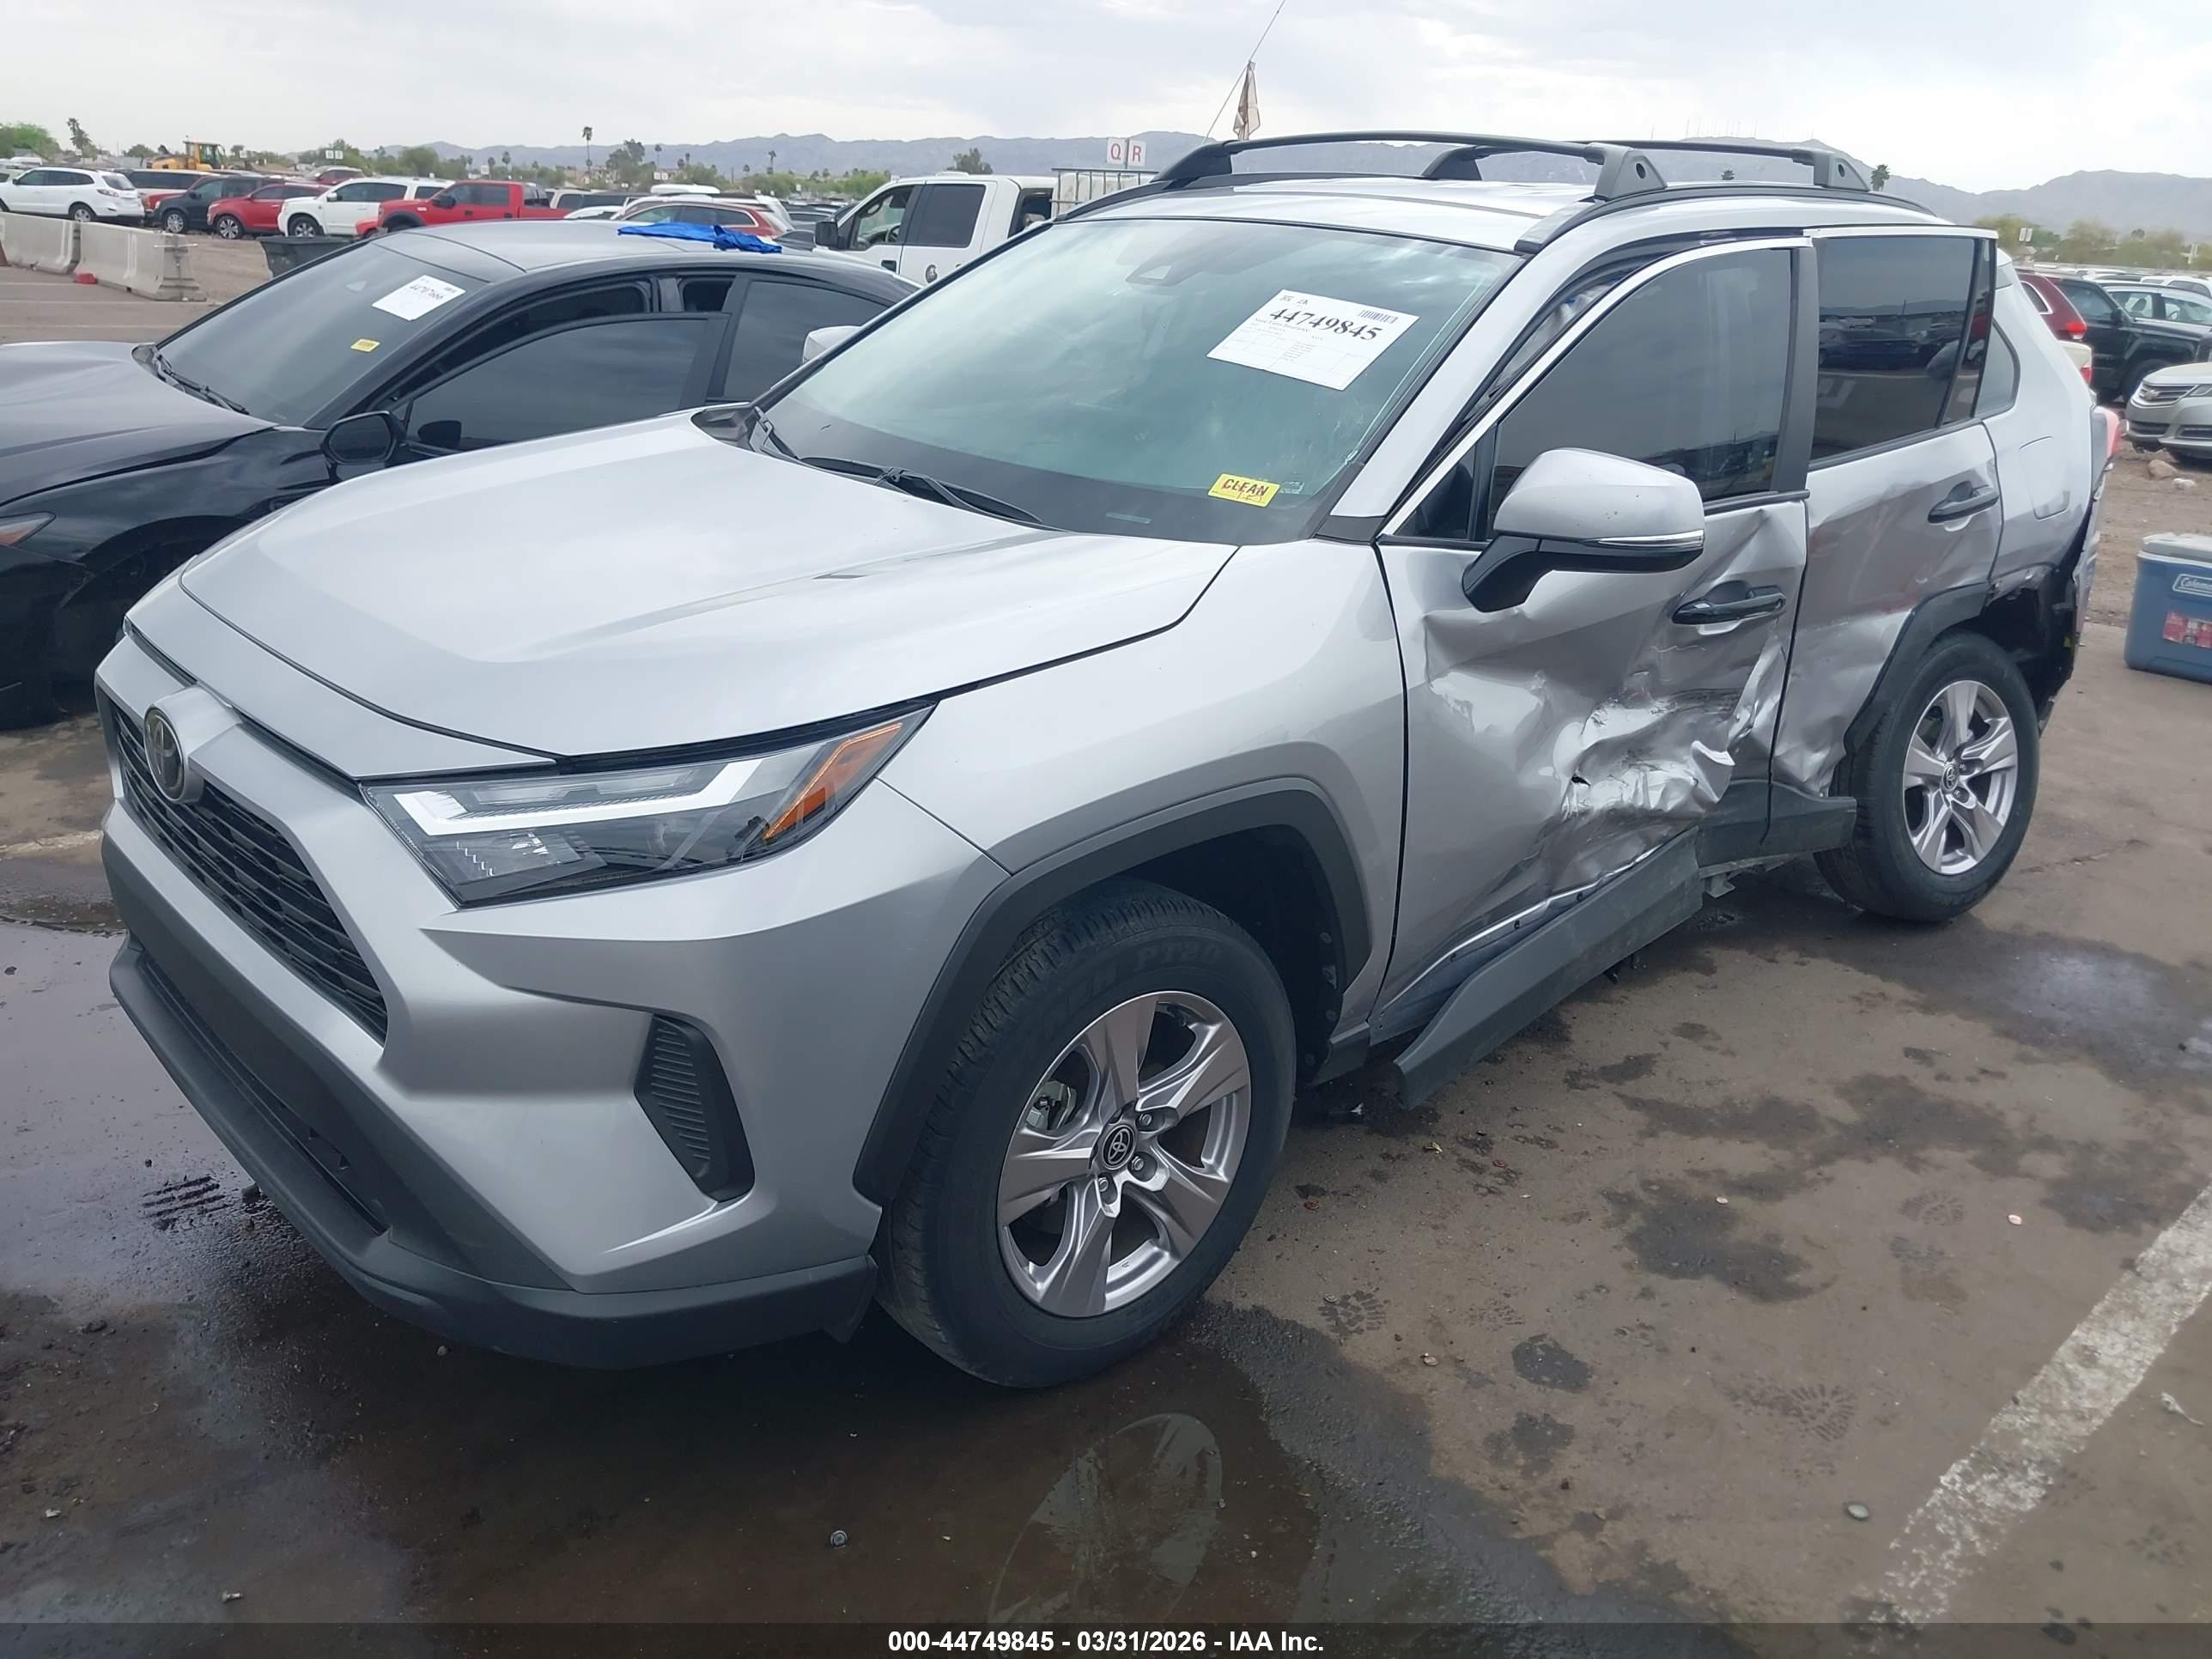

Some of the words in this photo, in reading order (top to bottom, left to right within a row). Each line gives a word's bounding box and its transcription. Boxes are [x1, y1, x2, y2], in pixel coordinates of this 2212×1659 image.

[1110, 143, 1121, 161] Q
[1132, 145, 1142, 162] R
[1269, 308, 1382, 340] 44749845
[1222, 478, 1269, 495] CLEAN
[2180, 577, 2212, 591] Colema
